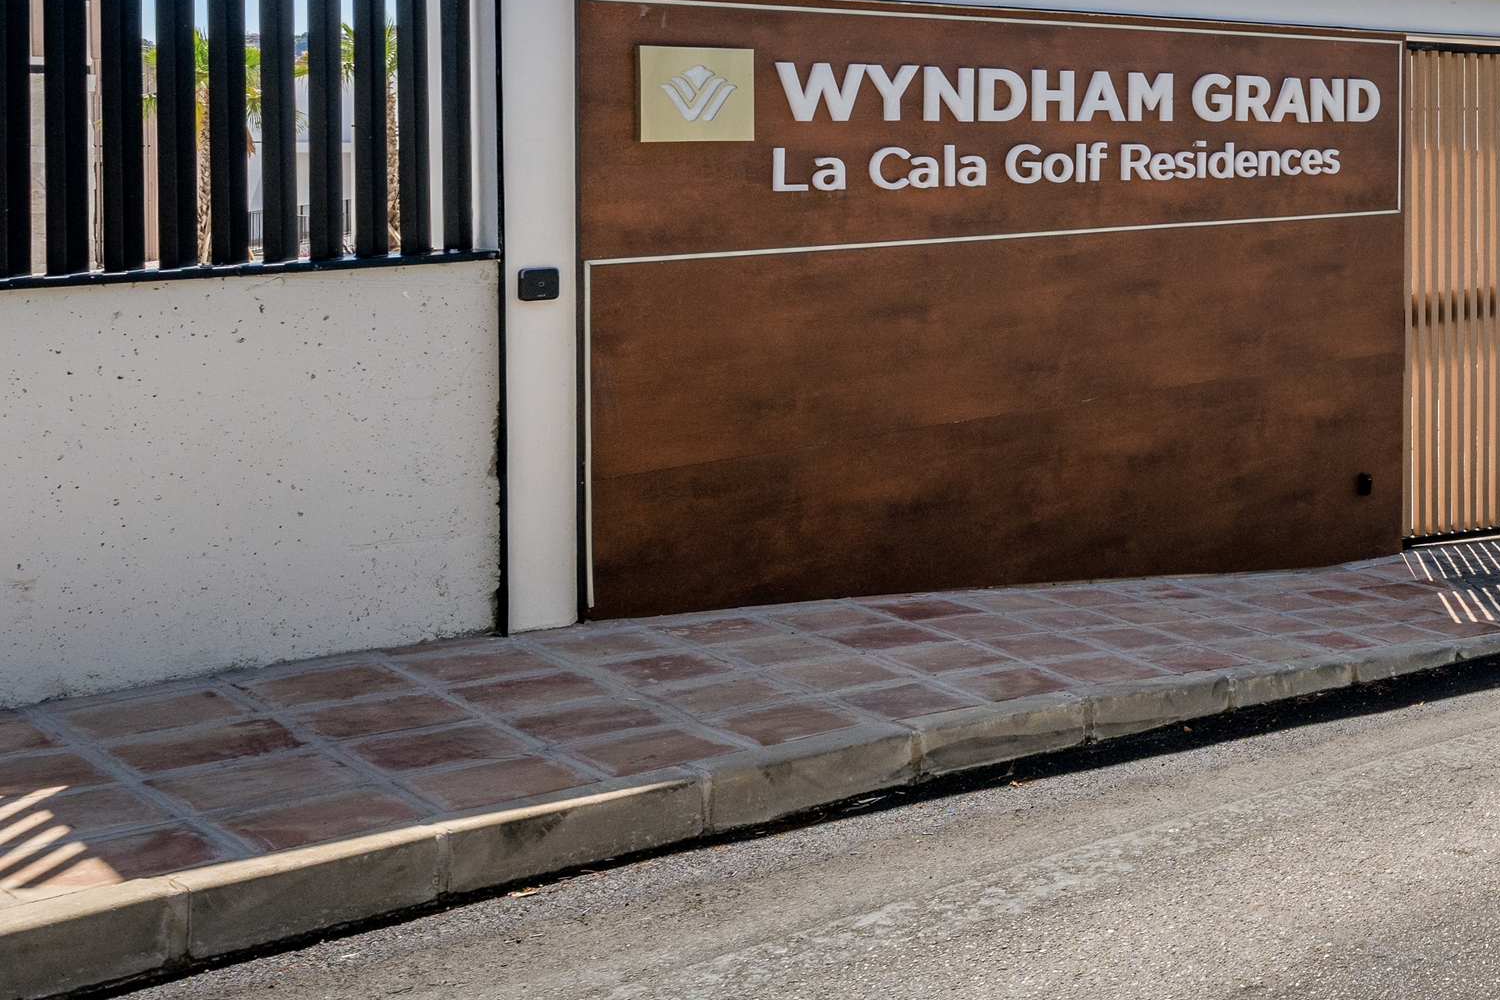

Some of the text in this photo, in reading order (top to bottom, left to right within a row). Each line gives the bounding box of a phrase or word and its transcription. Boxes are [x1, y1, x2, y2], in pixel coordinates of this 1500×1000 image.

[774, 61, 1381, 124] WYNDHAM GRAND
[772, 140, 1341, 192] La Cala Golf Residences
